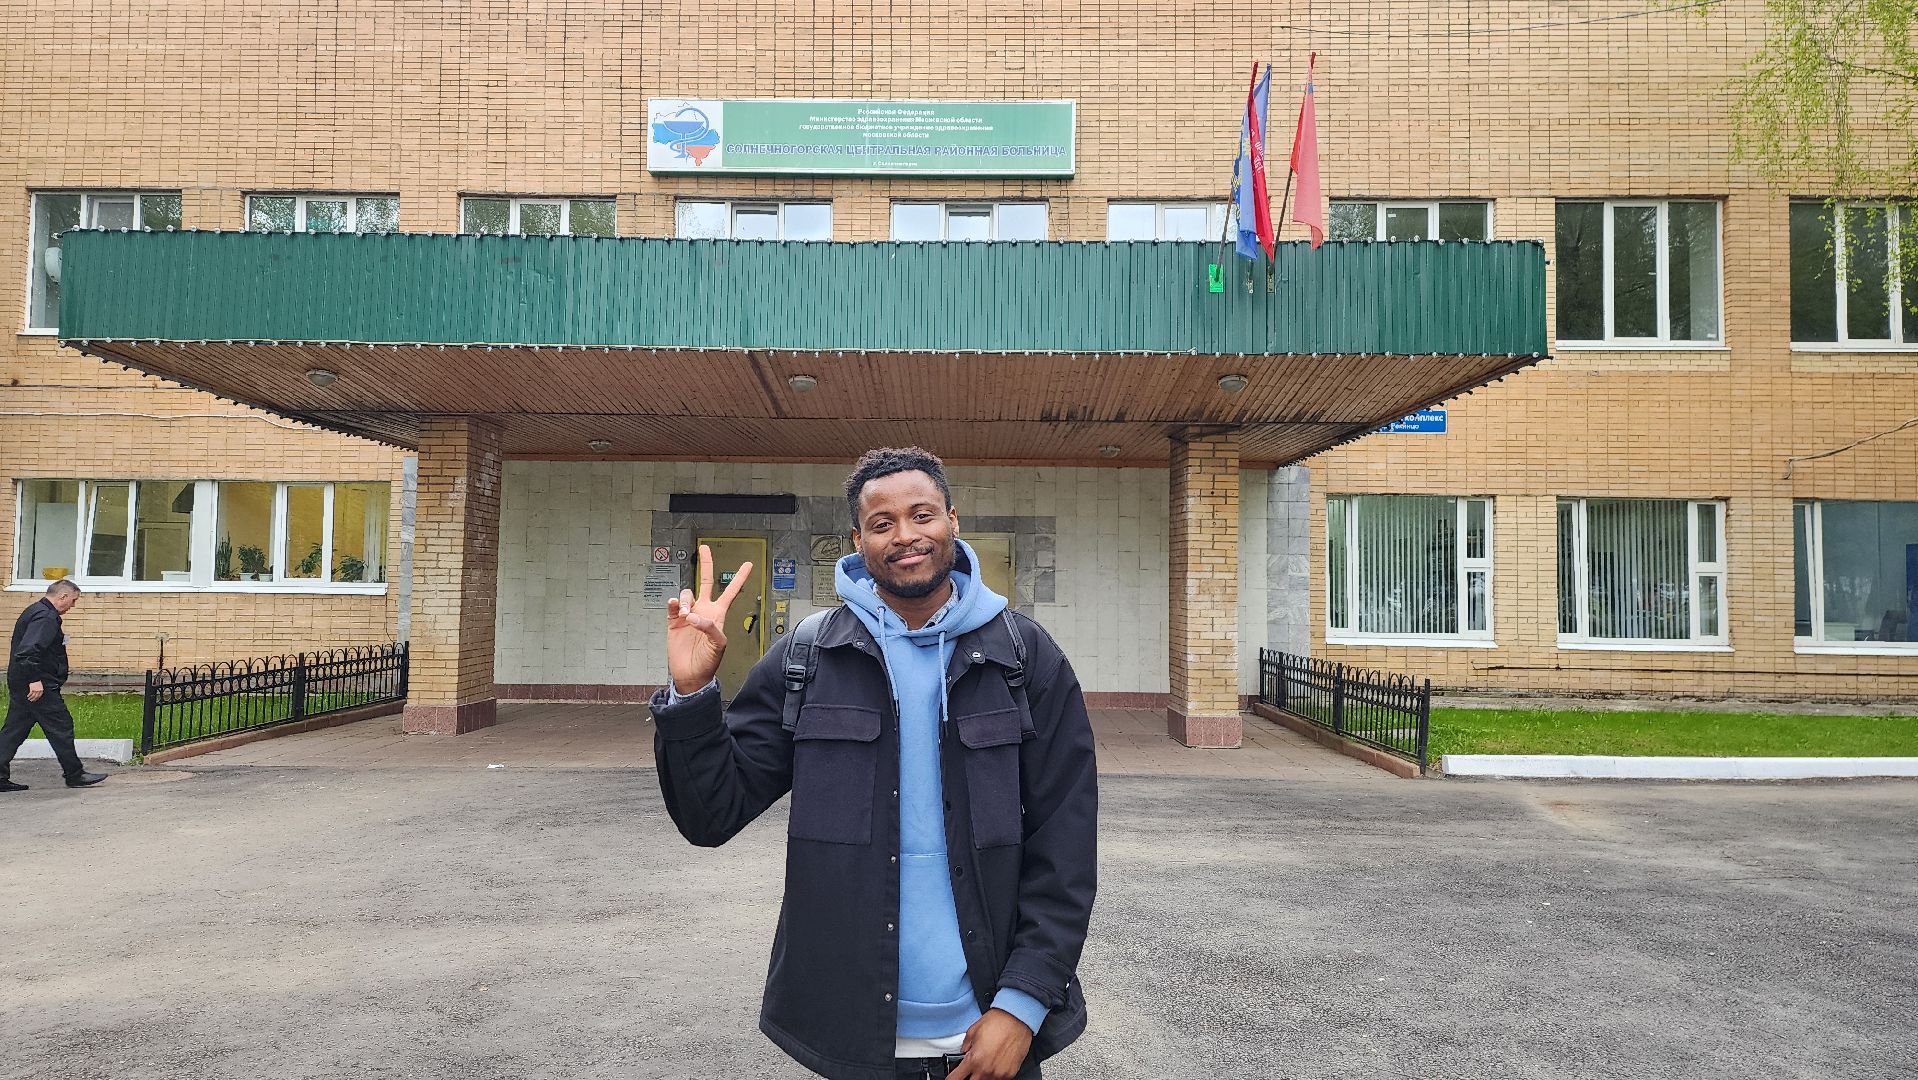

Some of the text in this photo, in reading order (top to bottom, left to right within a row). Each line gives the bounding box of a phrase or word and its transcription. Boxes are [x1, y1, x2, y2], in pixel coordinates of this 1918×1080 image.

[726, 143, 1067, 157] СОЛНЕЧНОГОРСКАЯ ЦЕНТРАЛЬНАЯ РАЙОННАЯ БОЛЬНИЦА
